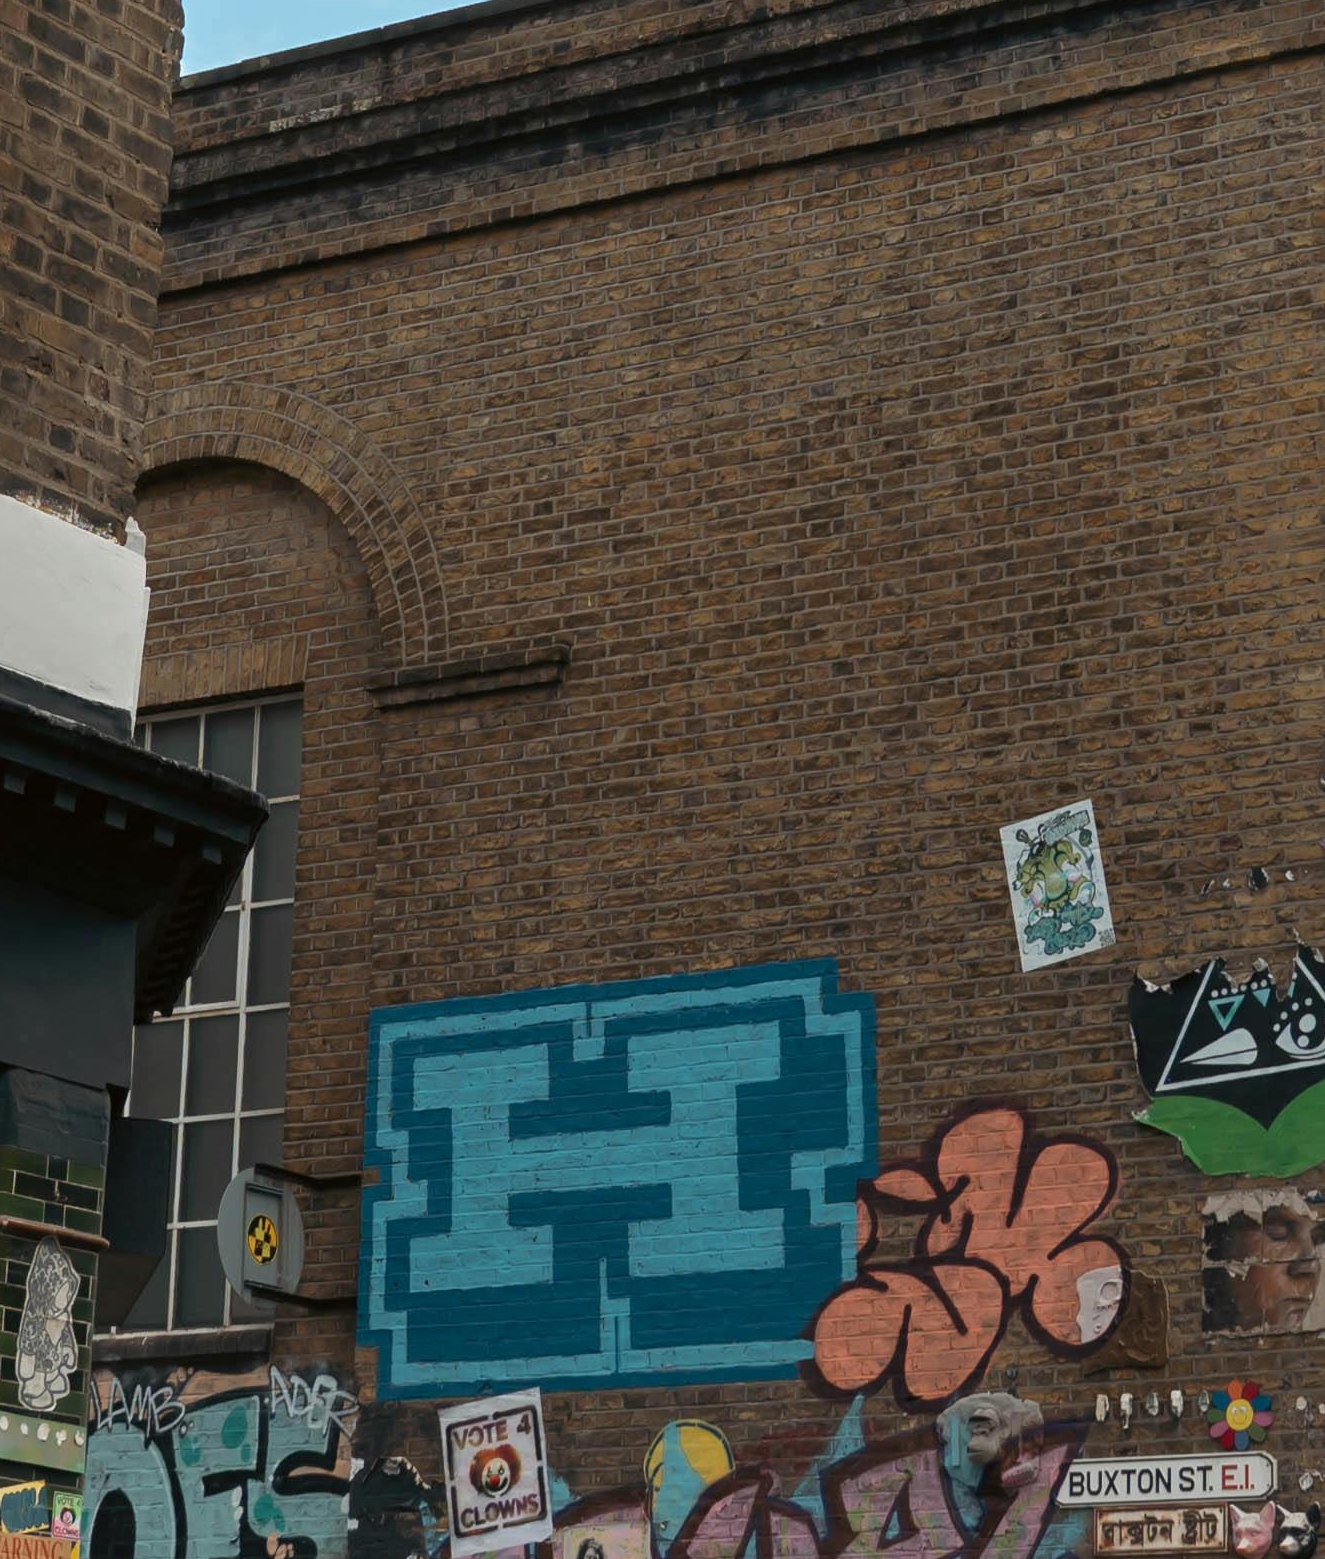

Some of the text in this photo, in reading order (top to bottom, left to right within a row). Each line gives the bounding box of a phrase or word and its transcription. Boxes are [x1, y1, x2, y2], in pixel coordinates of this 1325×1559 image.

[453, 1414, 531, 1451] VOTE 4
[1069, 1467, 1172, 1497] BUXTON
[1178, 1465, 1213, 1492] ST.
[460, 1494, 540, 1527] CLOWNS
